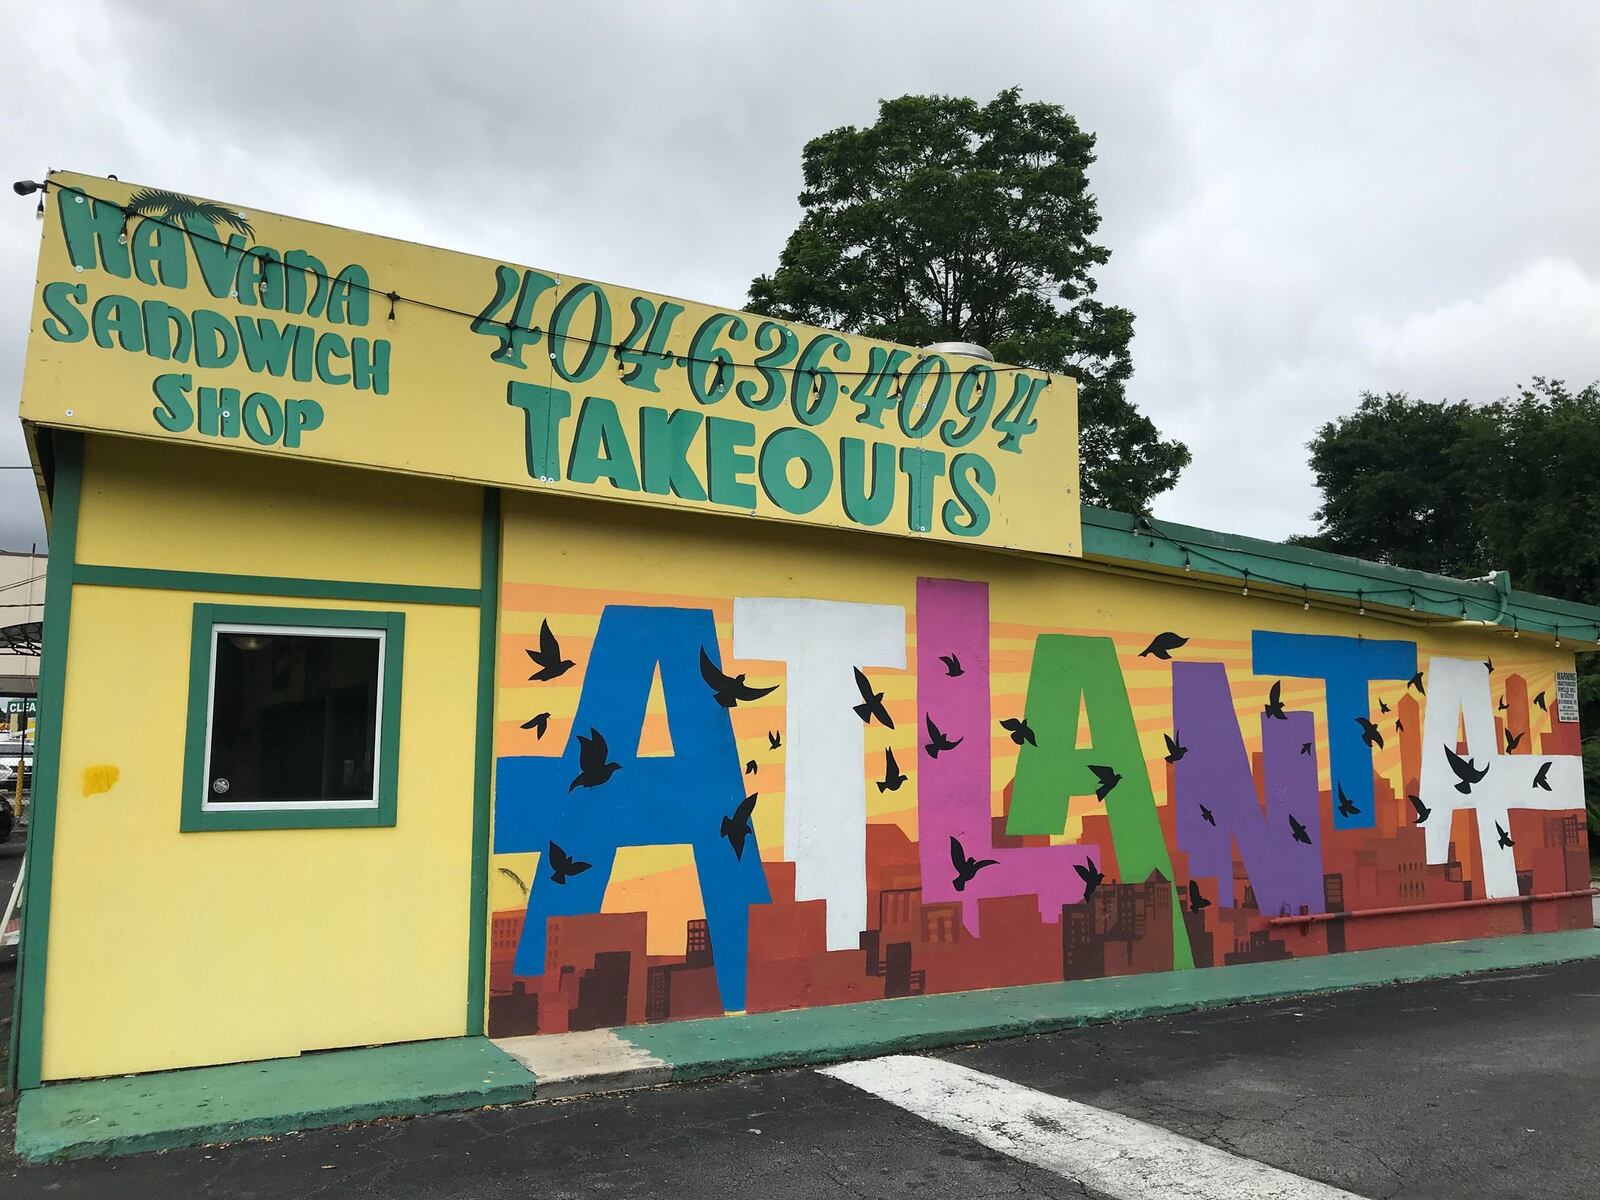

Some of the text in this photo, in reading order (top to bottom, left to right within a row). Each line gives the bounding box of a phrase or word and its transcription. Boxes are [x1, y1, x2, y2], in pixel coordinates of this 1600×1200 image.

[58, 187, 369, 326] HAVANA
[43, 282, 391, 395] SANDWICH
[153, 373, 324, 448] SHOP
[508, 381, 996, 537] TAKEOUTS
[493, 577, 1586, 1015] ATLANTA
